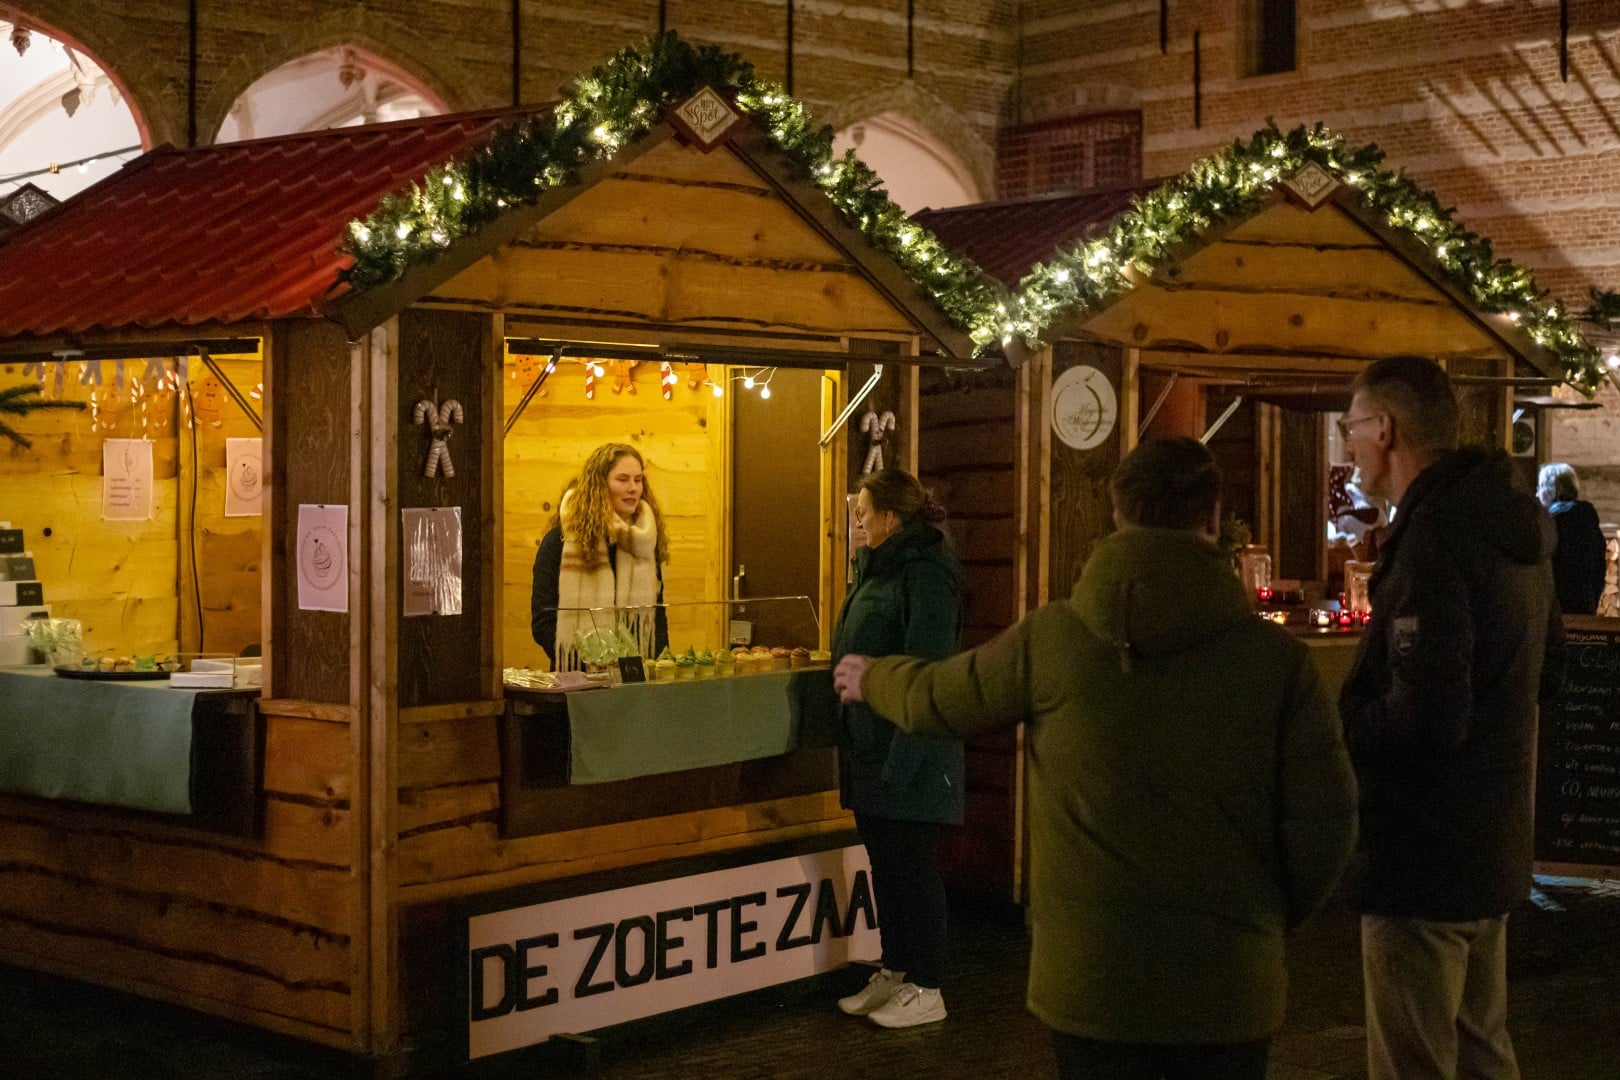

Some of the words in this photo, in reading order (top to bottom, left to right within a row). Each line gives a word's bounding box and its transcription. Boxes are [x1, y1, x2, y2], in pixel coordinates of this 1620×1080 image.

[690, 104, 720, 132] Spot
[471, 932, 559, 1022] DE
[573, 891, 767, 998] ZOETE
